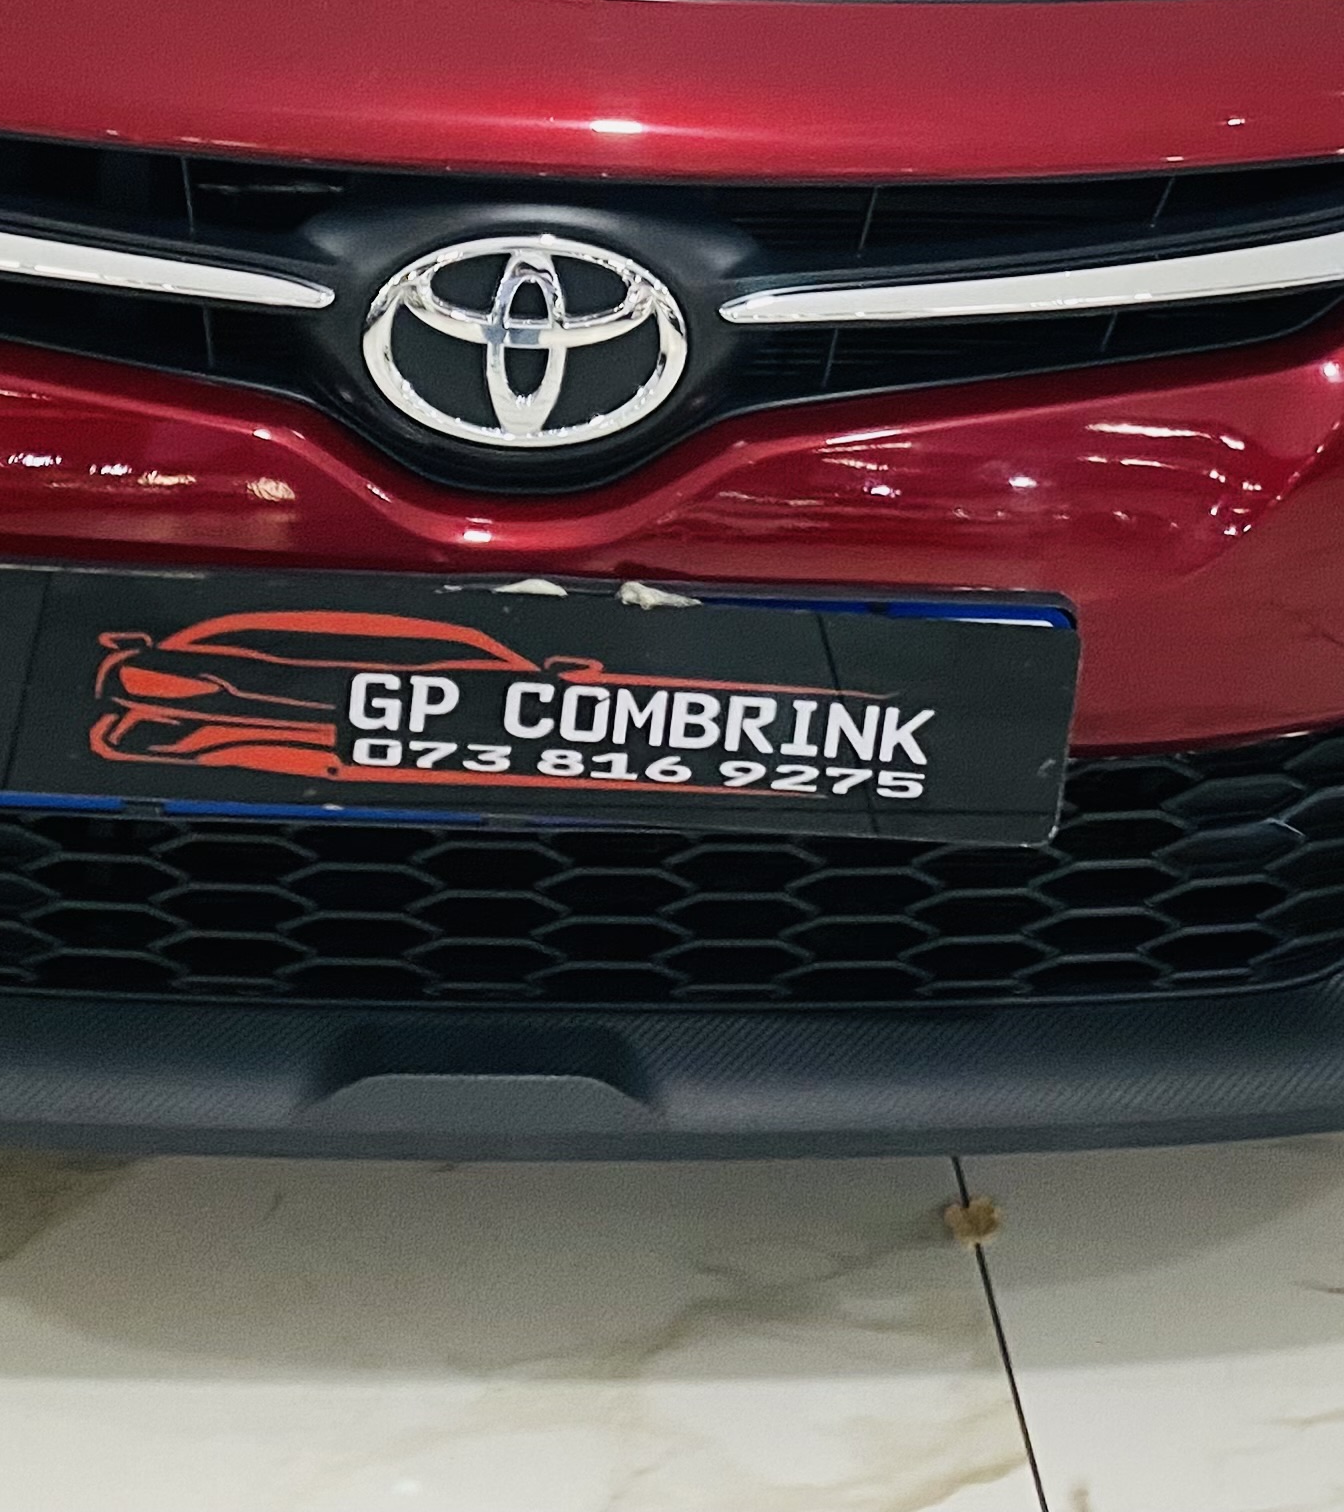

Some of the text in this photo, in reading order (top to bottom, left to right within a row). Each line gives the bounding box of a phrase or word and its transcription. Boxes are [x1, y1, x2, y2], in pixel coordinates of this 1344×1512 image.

[348, 672, 936, 766] GP COMBRINK
[352, 738, 927, 799] 073 816 9275
